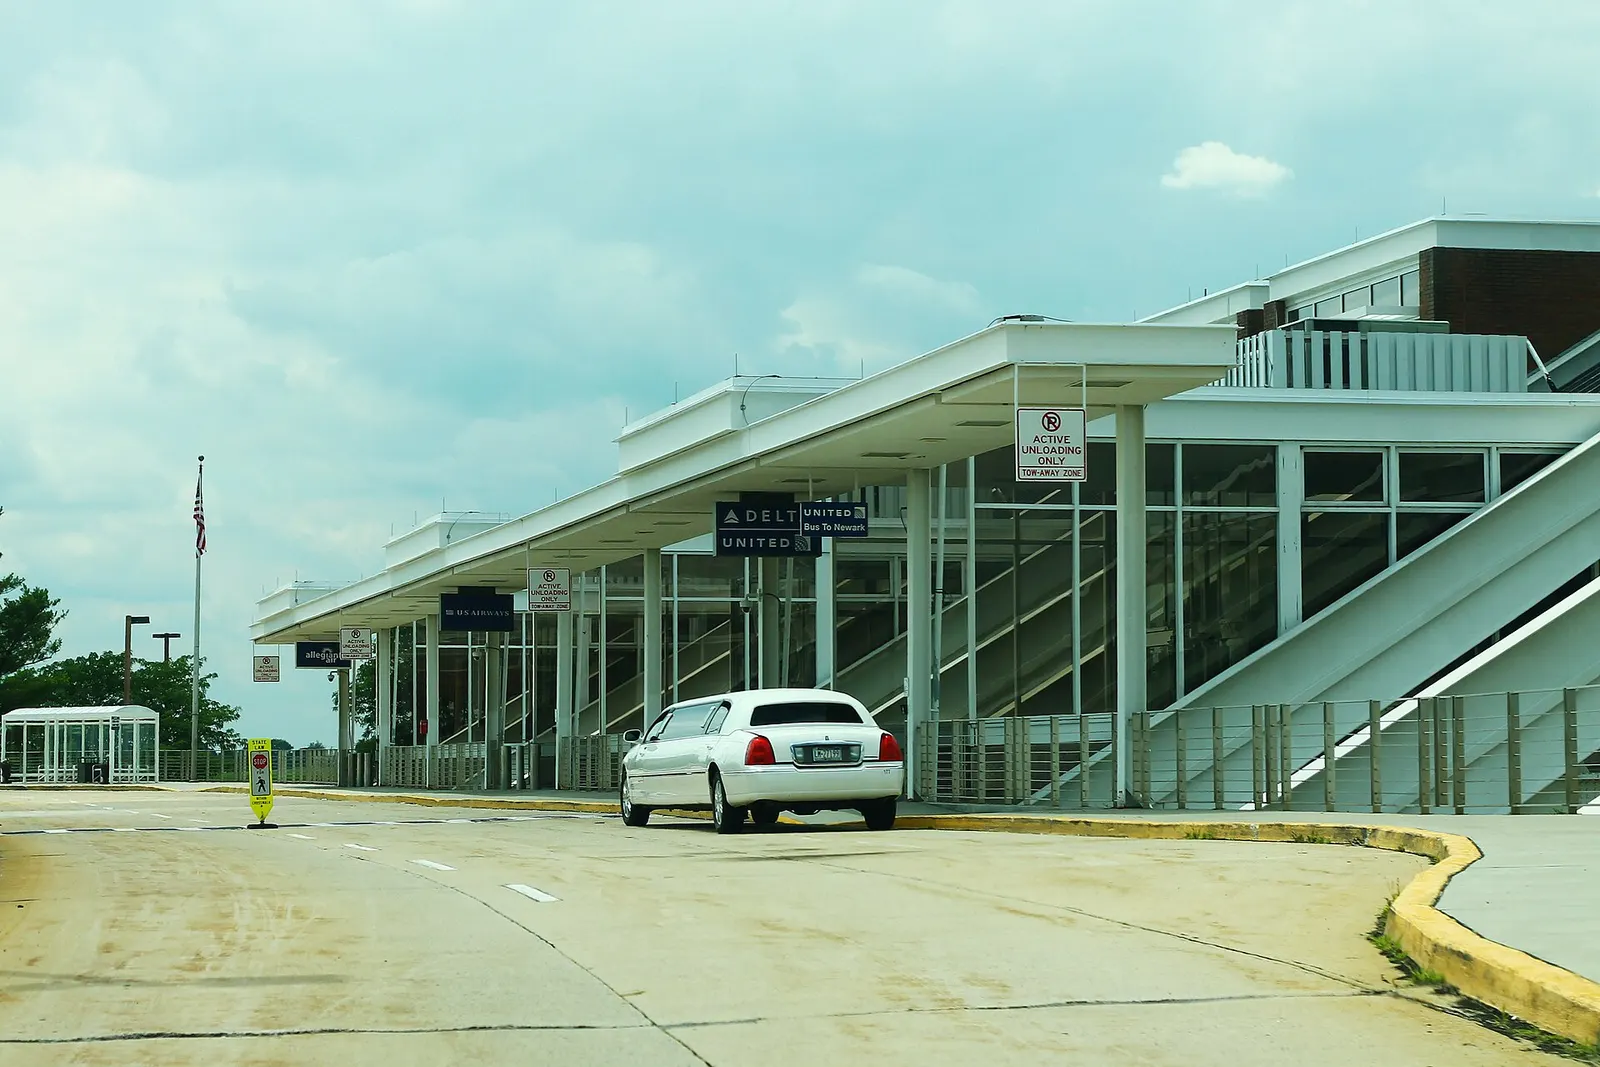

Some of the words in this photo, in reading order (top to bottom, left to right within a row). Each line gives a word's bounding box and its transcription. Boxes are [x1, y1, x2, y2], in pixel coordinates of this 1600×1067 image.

[1032, 435, 1071, 444] ACTIVE
[1021, 446, 1082, 454] UNLOADING
[1038, 456, 1066, 465] ONLY
[746, 510, 798, 522] DELT
[804, 508, 852, 517] UNITED
[804, 522, 820, 531] Bus
[822, 522, 832, 531] To
[834, 522, 866, 532] Newark
[722, 538, 790, 548] UNITED
[306, 650, 340, 660] allegian
